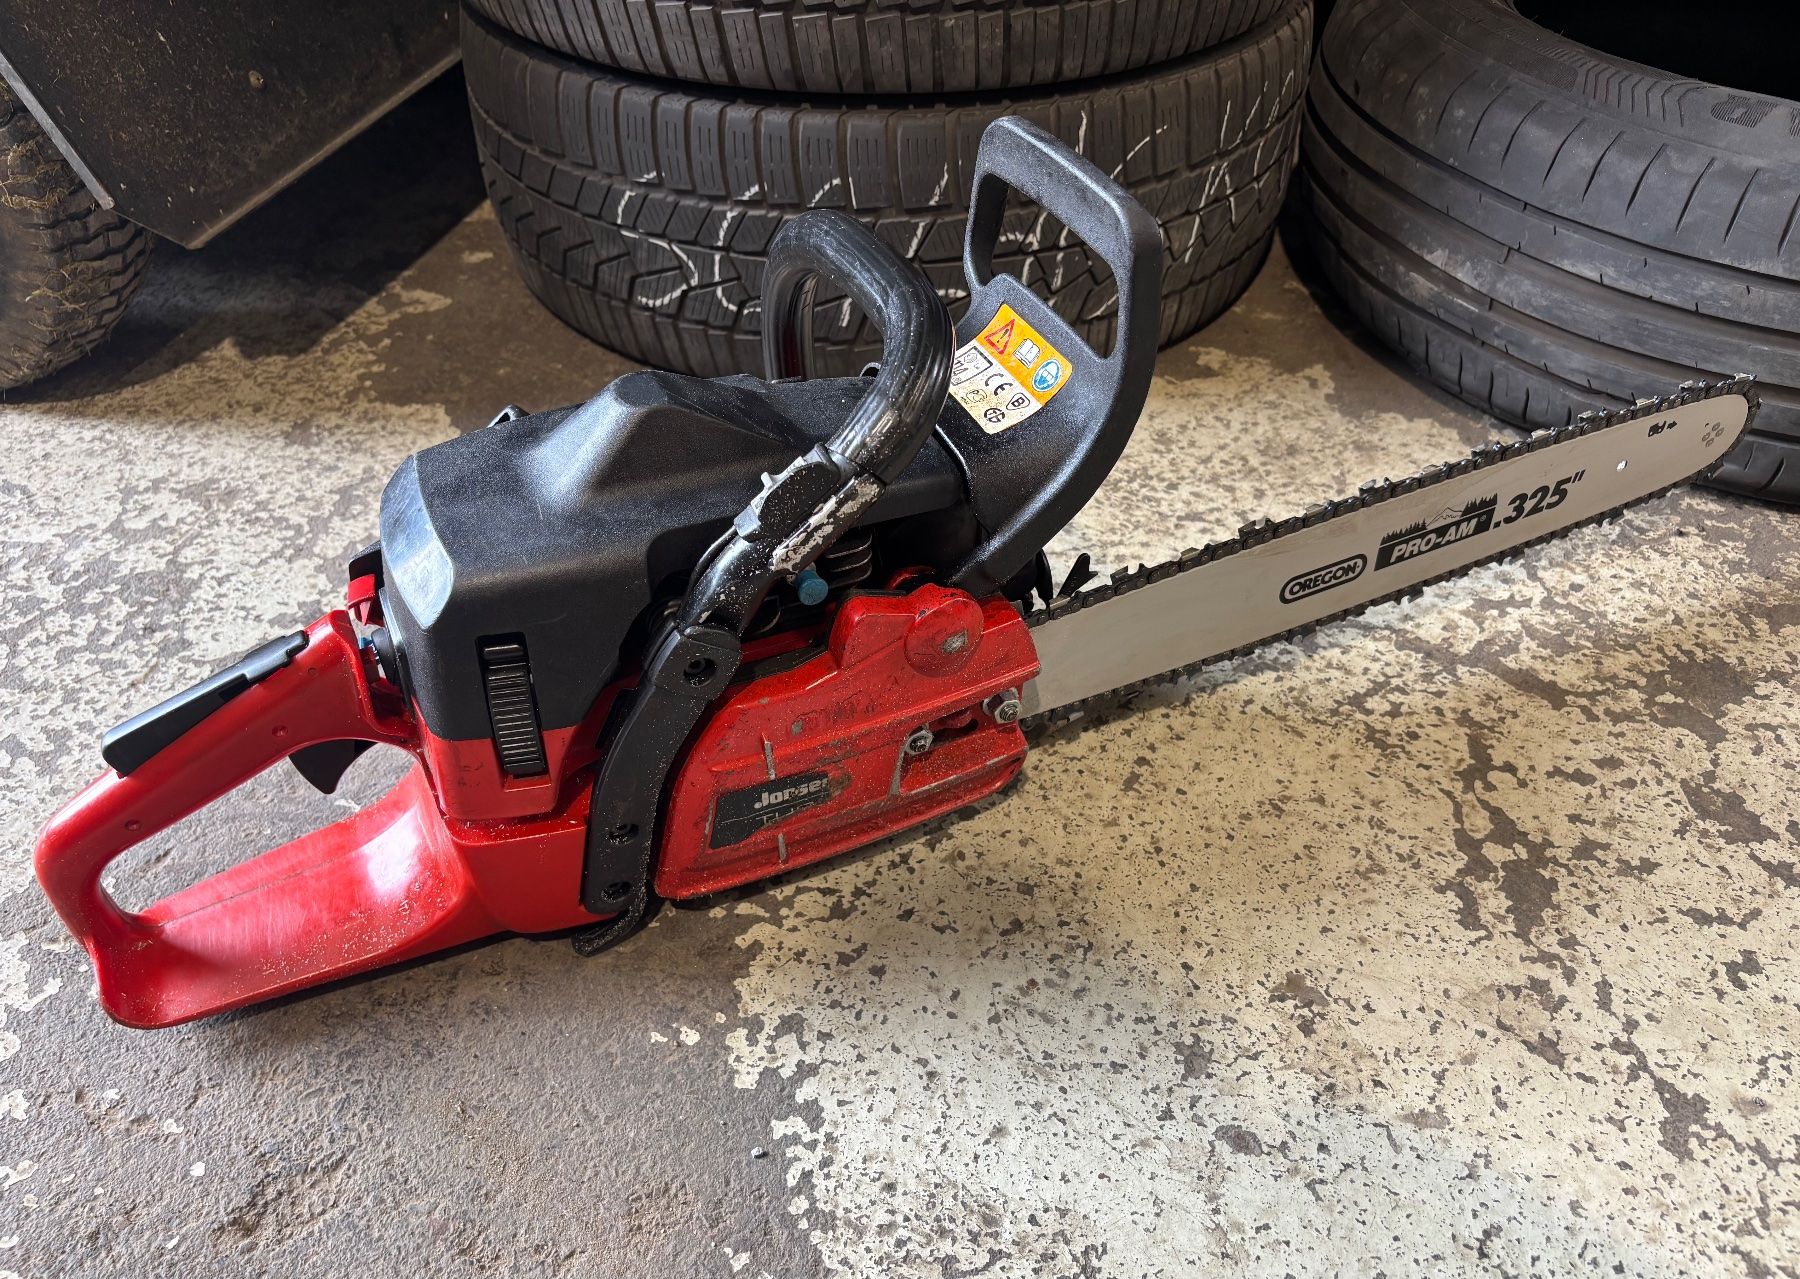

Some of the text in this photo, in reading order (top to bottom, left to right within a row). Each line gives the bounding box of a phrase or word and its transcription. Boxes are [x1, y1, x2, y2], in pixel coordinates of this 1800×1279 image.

[985, 373, 1013, 396] CE
[1288, 468, 1586, 596] OREGON PRO-AM .325"
